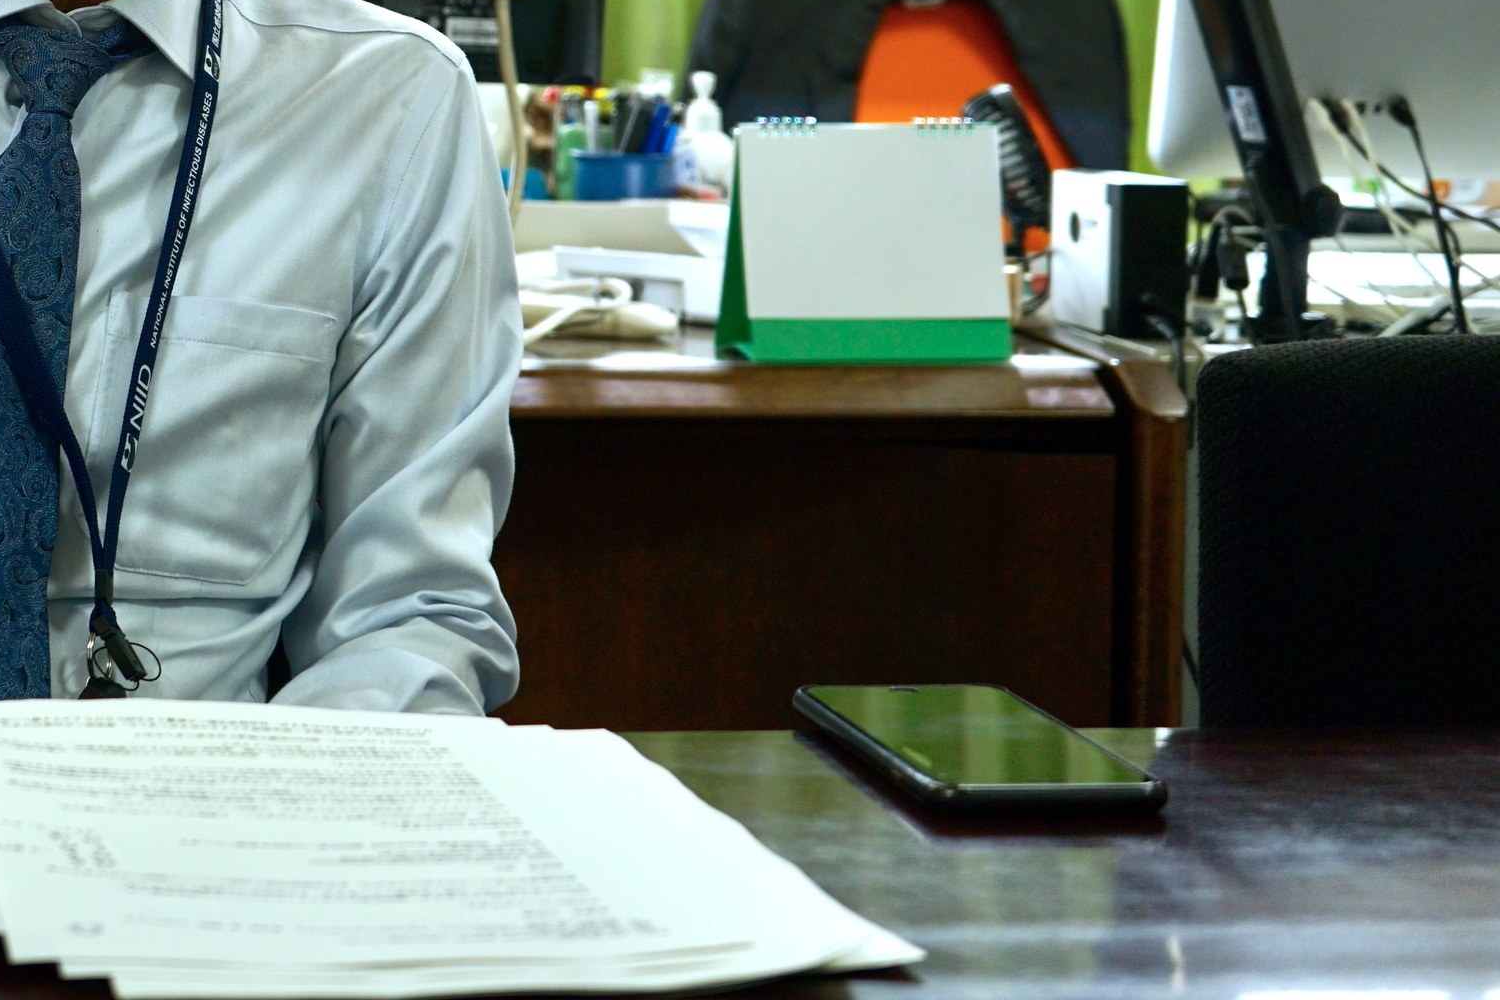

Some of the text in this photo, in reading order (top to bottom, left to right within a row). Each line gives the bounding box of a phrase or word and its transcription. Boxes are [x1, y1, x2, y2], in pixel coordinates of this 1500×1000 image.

[150, 91, 213, 348] NATIONAL INSTITUTE OF INFECTIOUS DISEASES
[130, 364, 151, 431] NIID
